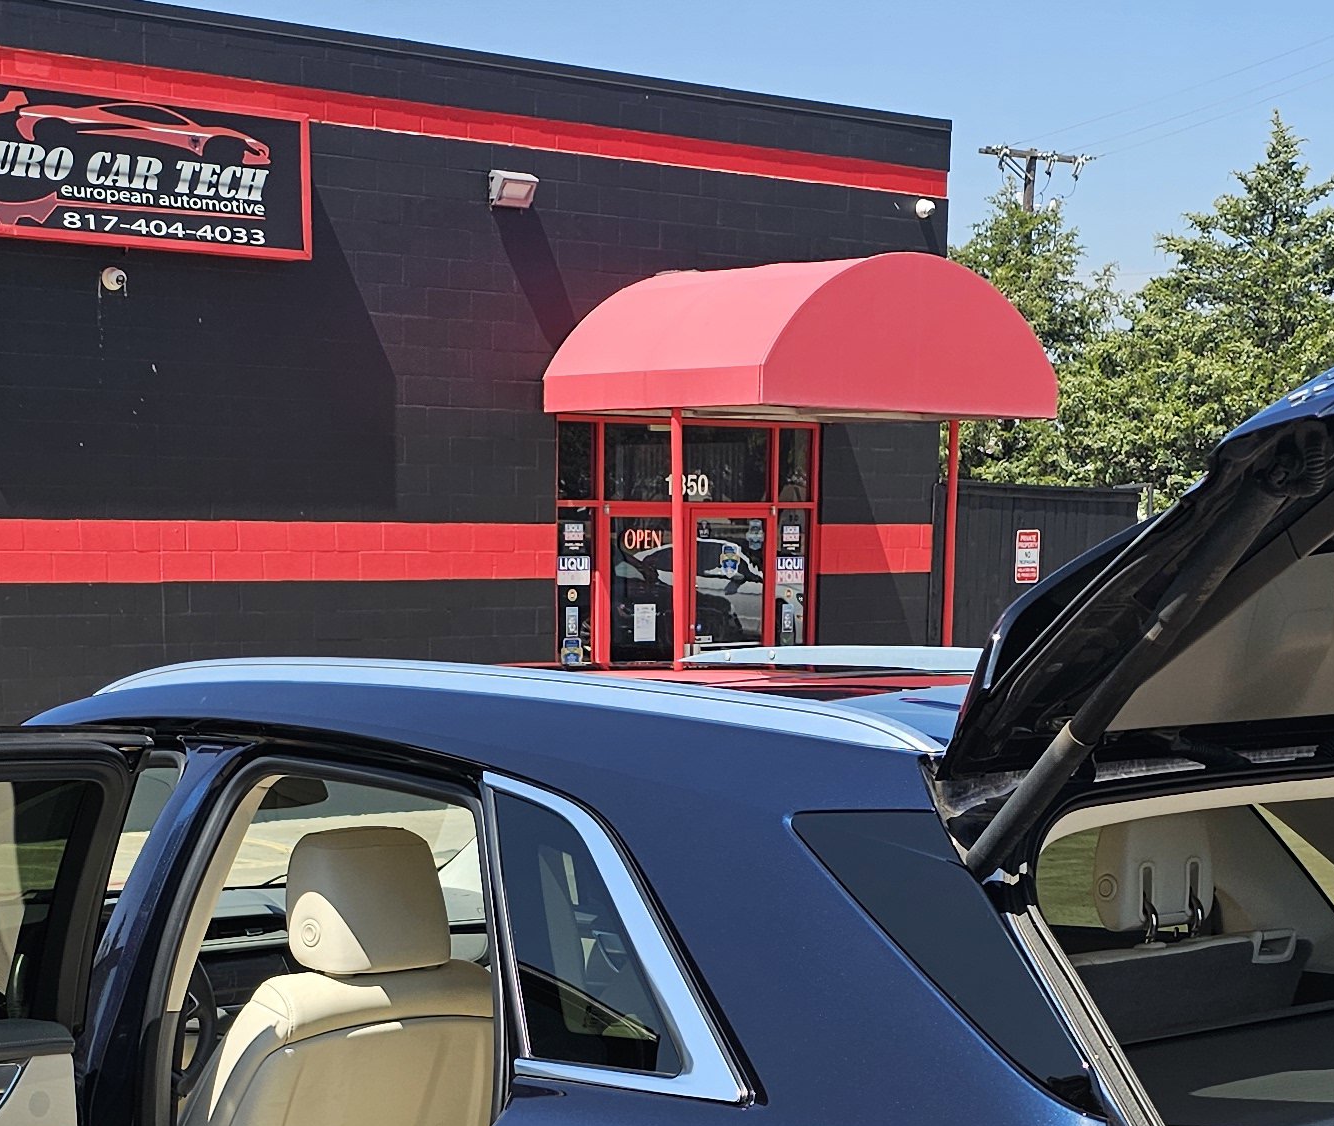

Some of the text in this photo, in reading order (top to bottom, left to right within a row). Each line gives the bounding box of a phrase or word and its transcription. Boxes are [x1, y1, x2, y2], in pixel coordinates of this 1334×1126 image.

[86, 151, 163, 191] CAR
[174, 160, 270, 202] TECH
[61, 184, 266, 216] european automotive
[63, 212, 266, 245] 817-404-4033
[624, 528, 662, 550] OPEN
[559, 557, 589, 571] LIQUI
[777, 558, 804, 570] LIQUI
